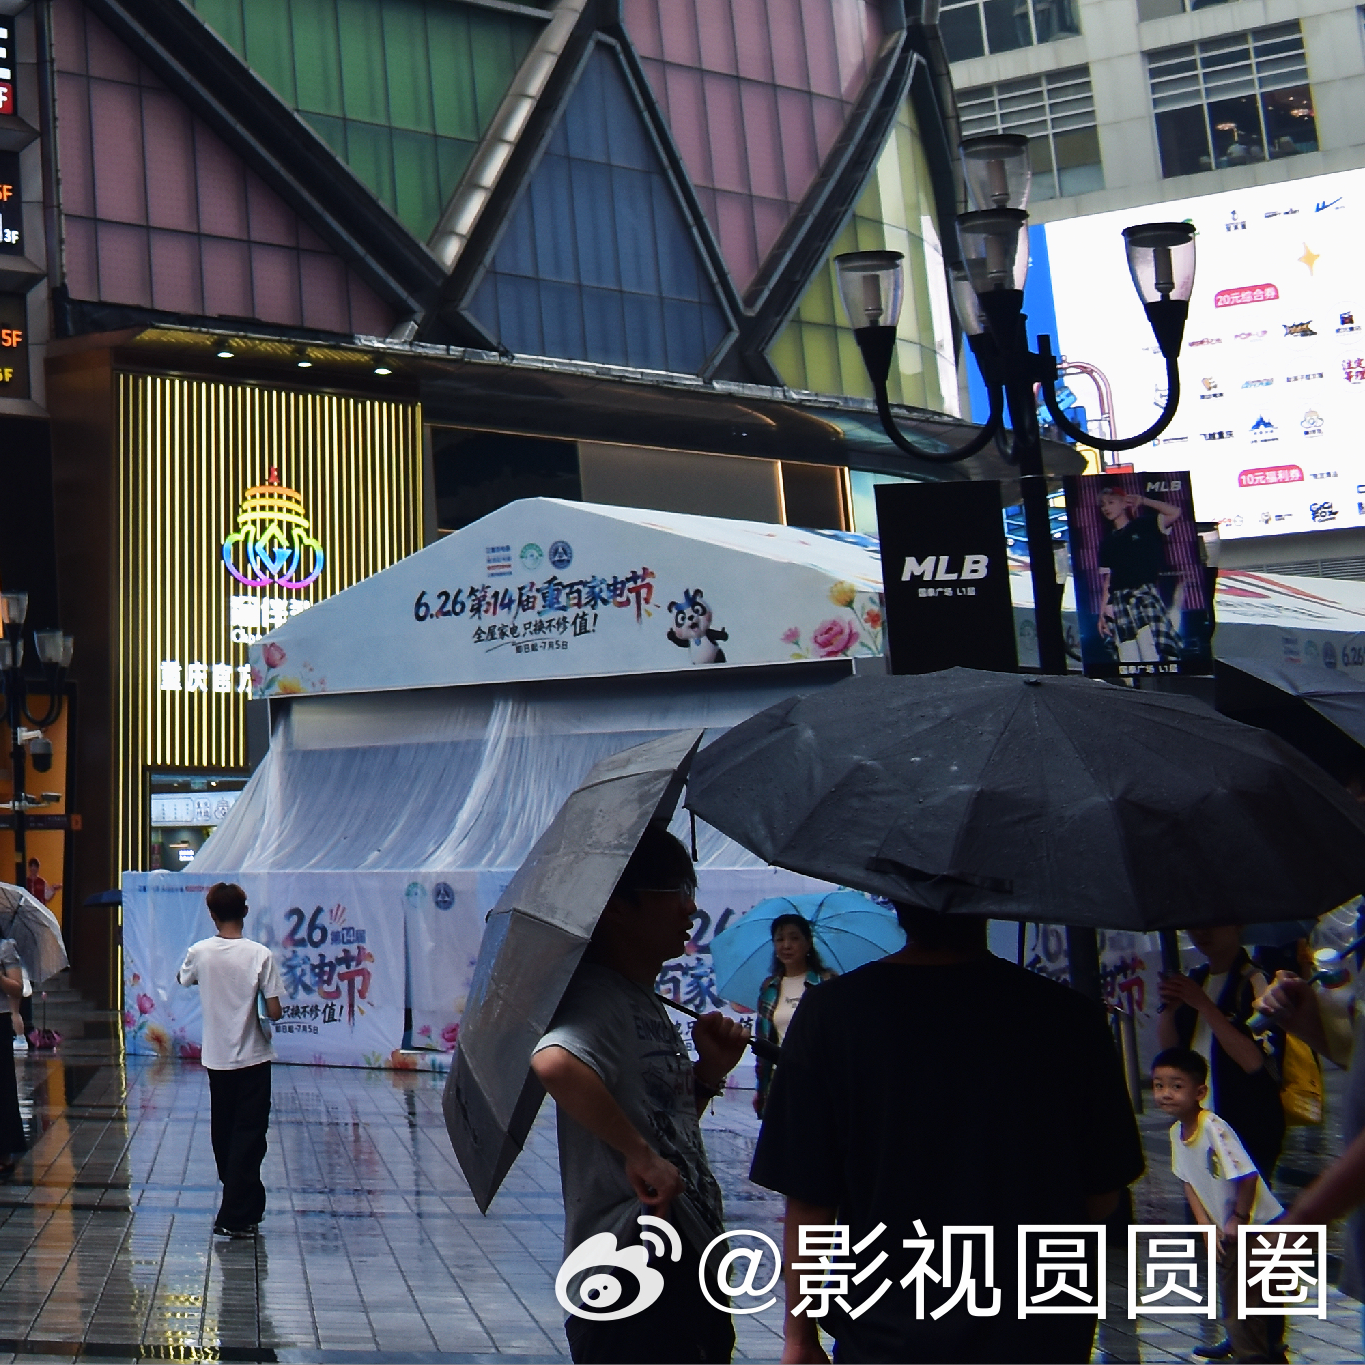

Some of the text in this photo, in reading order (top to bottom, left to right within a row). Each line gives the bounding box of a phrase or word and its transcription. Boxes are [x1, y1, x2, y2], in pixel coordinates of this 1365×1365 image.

[4, 228, 19, 244] 3F
[1, 329, 23, 348] 5F
[1146, 480, 1182, 493] MLB
[900, 554, 989, 582] MLB
